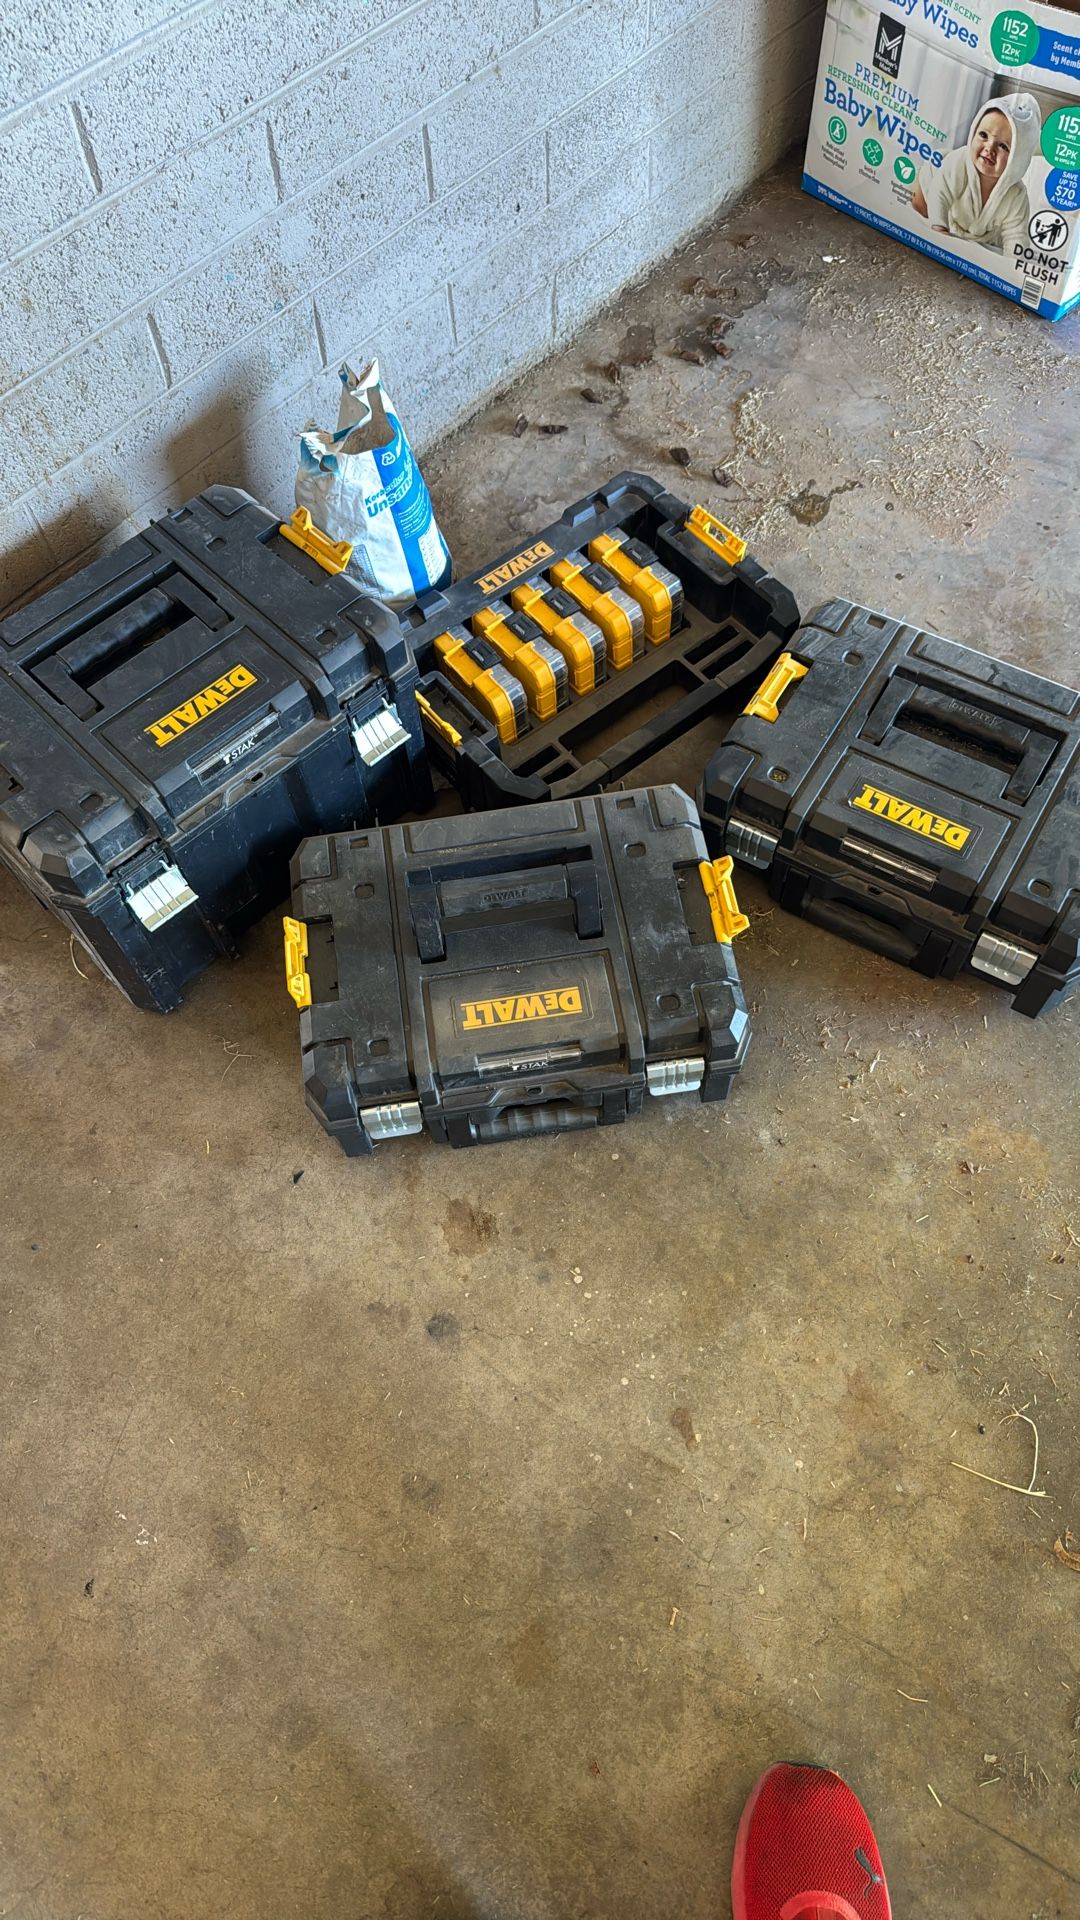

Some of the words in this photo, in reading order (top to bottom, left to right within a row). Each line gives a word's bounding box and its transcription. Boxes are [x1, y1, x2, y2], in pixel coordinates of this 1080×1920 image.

[923, 0, 979, 48] Wipes
[954, 4, 981, 25] SCENT
[1003, 16, 1029, 37] 1152
[1050, 52, 1059, 65] by
[1053, 41, 1073, 54] Scent
[856, 62, 919, 112] PREMIUM
[827, 64, 880, 101] REFRESHING
[881, 95, 913, 121] CLEAN
[914, 116, 948, 143] SCENT
[824, 77, 873, 127] Baby
[875, 104, 944, 168] Wipes
[1058, 114, 1080, 135] 115
[1058, 179, 1068, 187] UP
[1068, 180, 1078, 189] TO
[1062, 171, 1078, 182] SAVE
[1050, 195, 1056, 203] A
[1054, 185, 1076, 200] $70
[1013, 243, 1035, 260] DO
[1037, 252, 1069, 273] NOT
[1015, 259, 1059, 285] FLUSH
[474, 541, 556, 596] DEWALT
[144, 664, 258, 747] DEWALT
[853, 783, 972, 851] DEWALT
[460, 986, 583, 1031] DEWALT
